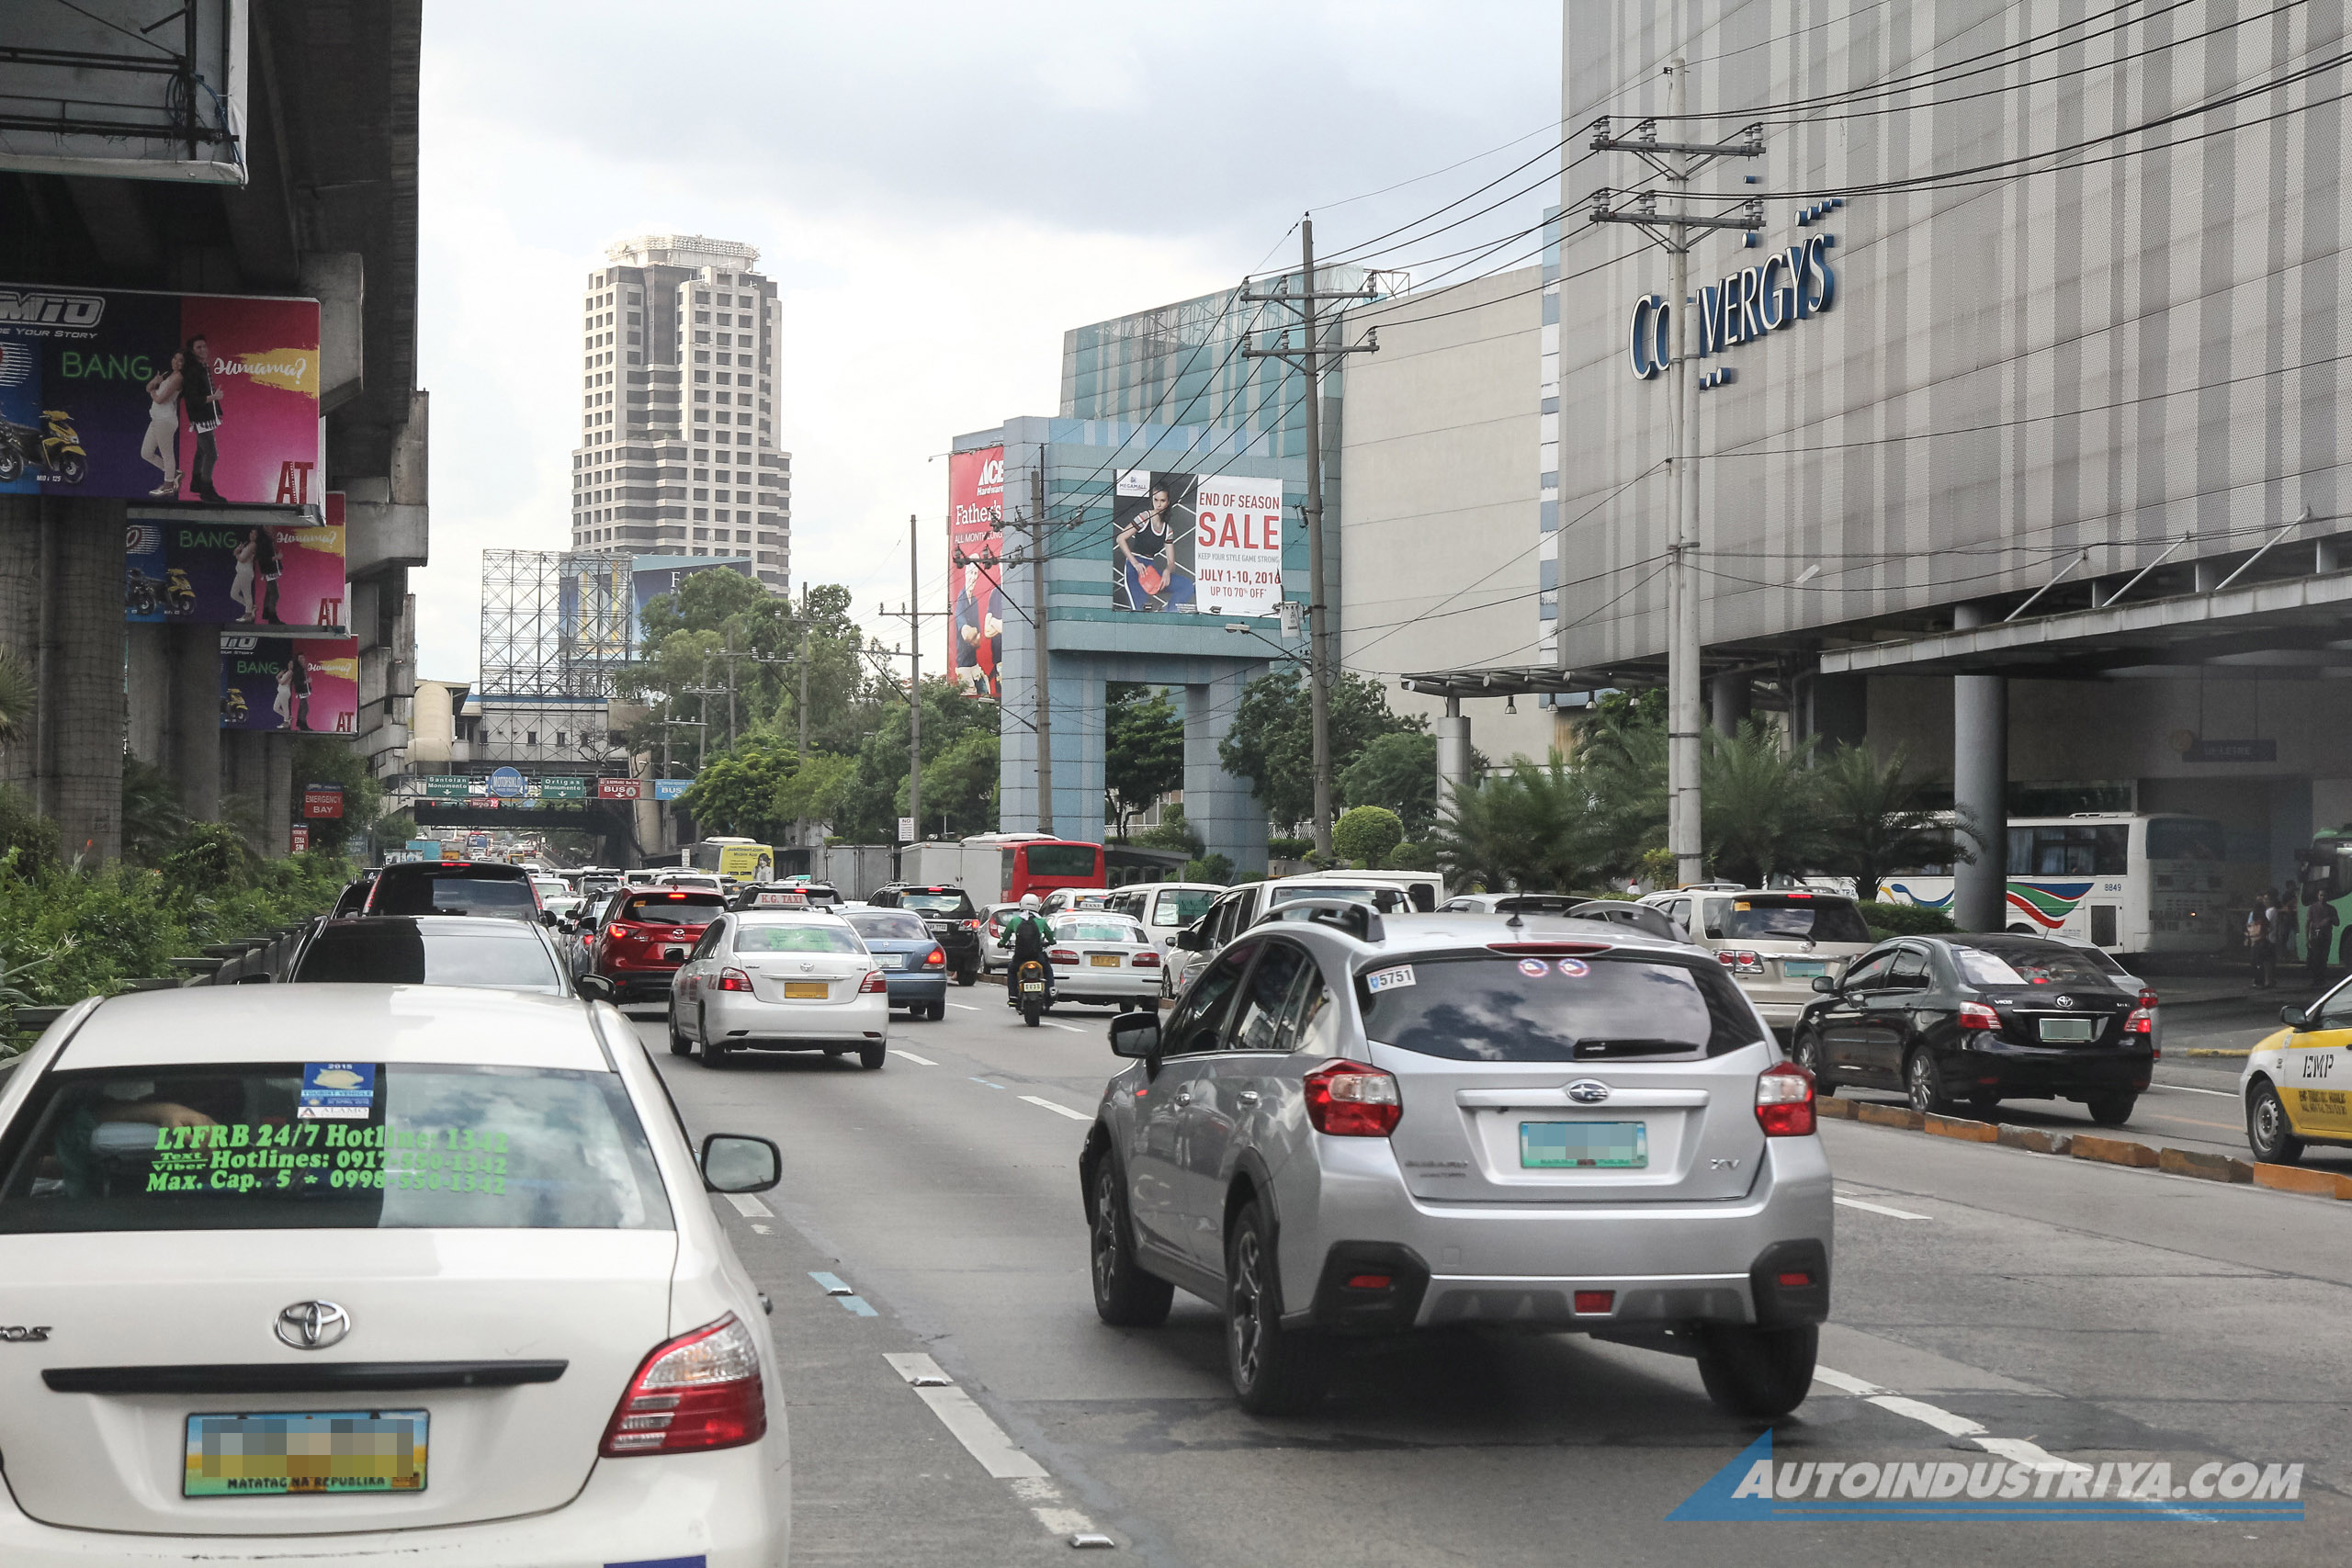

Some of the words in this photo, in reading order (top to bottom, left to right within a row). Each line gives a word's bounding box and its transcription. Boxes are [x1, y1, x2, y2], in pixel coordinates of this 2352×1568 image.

[1629, 233, 1834, 380] COVERGYS
[16, 328, 50, 336] YOUR
[54, 330, 97, 338] STORY
[62, 351, 153, 380] BANG
[978, 458, 1004, 486] ACE
[277, 461, 314, 504] AT
[977, 485, 1004, 496] Hardware
[1199, 492, 1220, 506] END
[1222, 494, 1236, 507] OF
[1238, 494, 1280, 509] SEASON
[956, 500, 1001, 525] Father's
[179, 530, 238, 548] BANG
[955, 535, 964, 544] ALL
[965, 532, 986, 543] MONTH
[1198, 512, 1280, 550] SALE
[1198, 552, 1211, 560] KEEP
[1212, 553, 1225, 561] YOUR
[1226, 554, 1241, 562] STYLE
[1241, 555, 1256, 563] GAME
[1198, 569, 1224, 581] JULY
[1226, 570, 1253, 585] 1-10,
[1255, 571, 1282, 585] 2016
[1210, 586, 1221, 596] UP
[1224, 586, 1233, 597] TO
[1235, 587, 1249, 597] 70%
[317, 598, 342, 626] AT
[237, 660, 279, 675] BANG
[336, 711, 355, 732] AT
[305, 795, 342, 804] EMERGENCY
[313, 806, 333, 814] BAY
[2104, 884, 2122, 892] 8849
[761, 895, 779, 904] K.G.
[782, 895, 803, 904] TAXI
[1379, 969, 1412, 987] 5751
[154, 1123, 251, 1151] LTFRB
[255, 1122, 321, 1148] 24/7
[324, 1123, 438, 1149] Hotline:
[447, 1128, 507, 1155] 1342
[160, 1151, 202, 1160] Text
[209, 1149, 330, 1169] Hotlines:
[336, 1149, 507, 1176] 0917-550-1342
[152, 1163, 206, 1172] Viber
[1710, 1158, 1740, 1170] XV
[146, 1171, 203, 1192] Max.
[209, 1168, 263, 1193] Cap.
[276, 1168, 292, 1189] 5
[329, 1168, 506, 1195] 0998-550-1342
[228, 1477, 288, 1489] MATATAG
[290, 1477, 310, 1487] NA
[313, 1476, 386, 1487] REPUBLIKA
